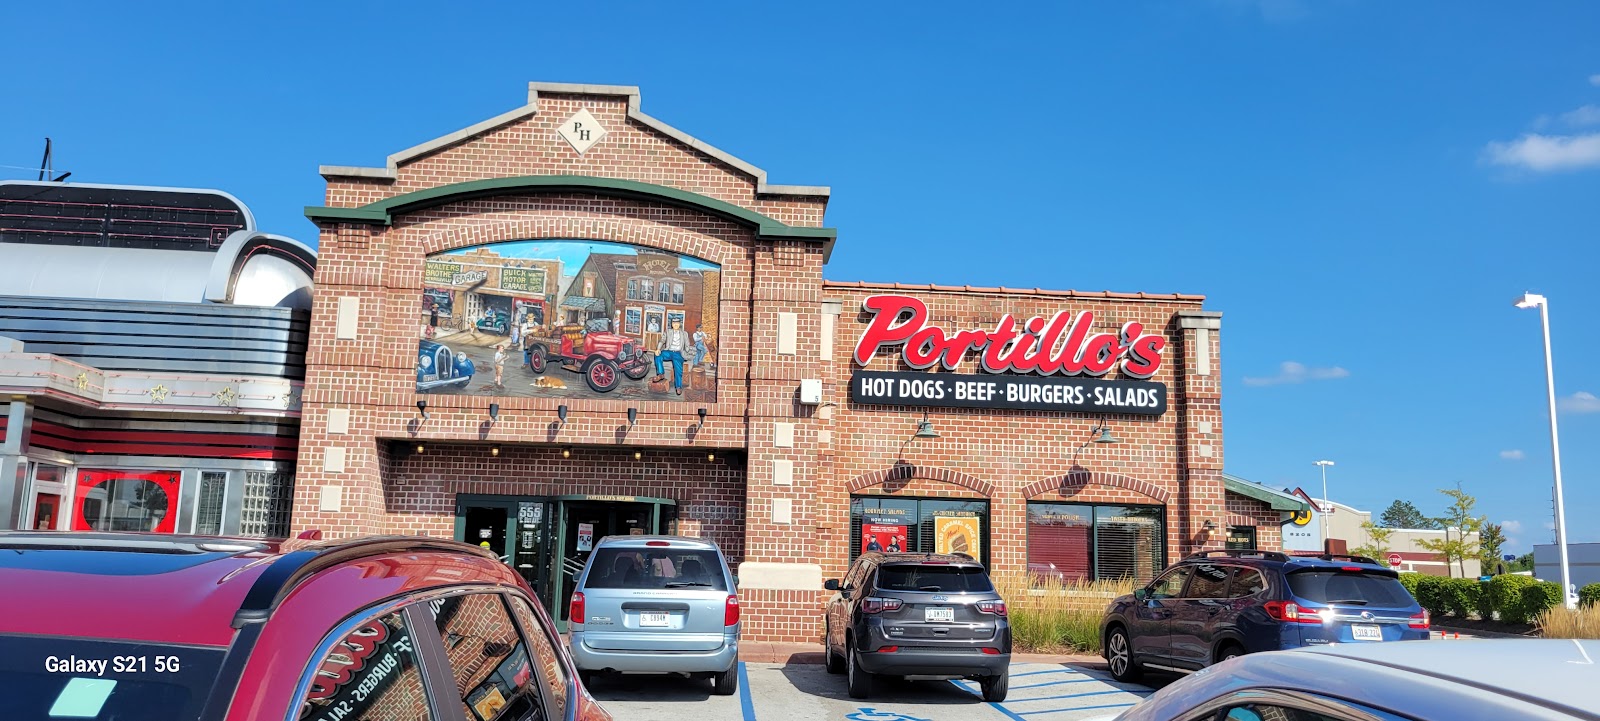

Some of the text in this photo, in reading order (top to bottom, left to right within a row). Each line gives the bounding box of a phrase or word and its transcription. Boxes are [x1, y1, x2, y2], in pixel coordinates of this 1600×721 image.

[427, 263, 460, 271] WALTERS
[643, 259, 670, 273] HOTEL
[426, 269, 452, 278] BROTHE
[455, 271, 487, 284] GARAGE
[503, 269, 526, 277] BUICK
[503, 283, 527, 291] GARAGE
[854, 295, 1165, 378] Portillo's
[861, 378, 1158, 408] HOT DOGS BEEF BURGERS SALADS
[519, 506, 541, 518] 555
[941, 520, 964, 532] CARAMEL
[964, 523, 976, 538] SPICE
